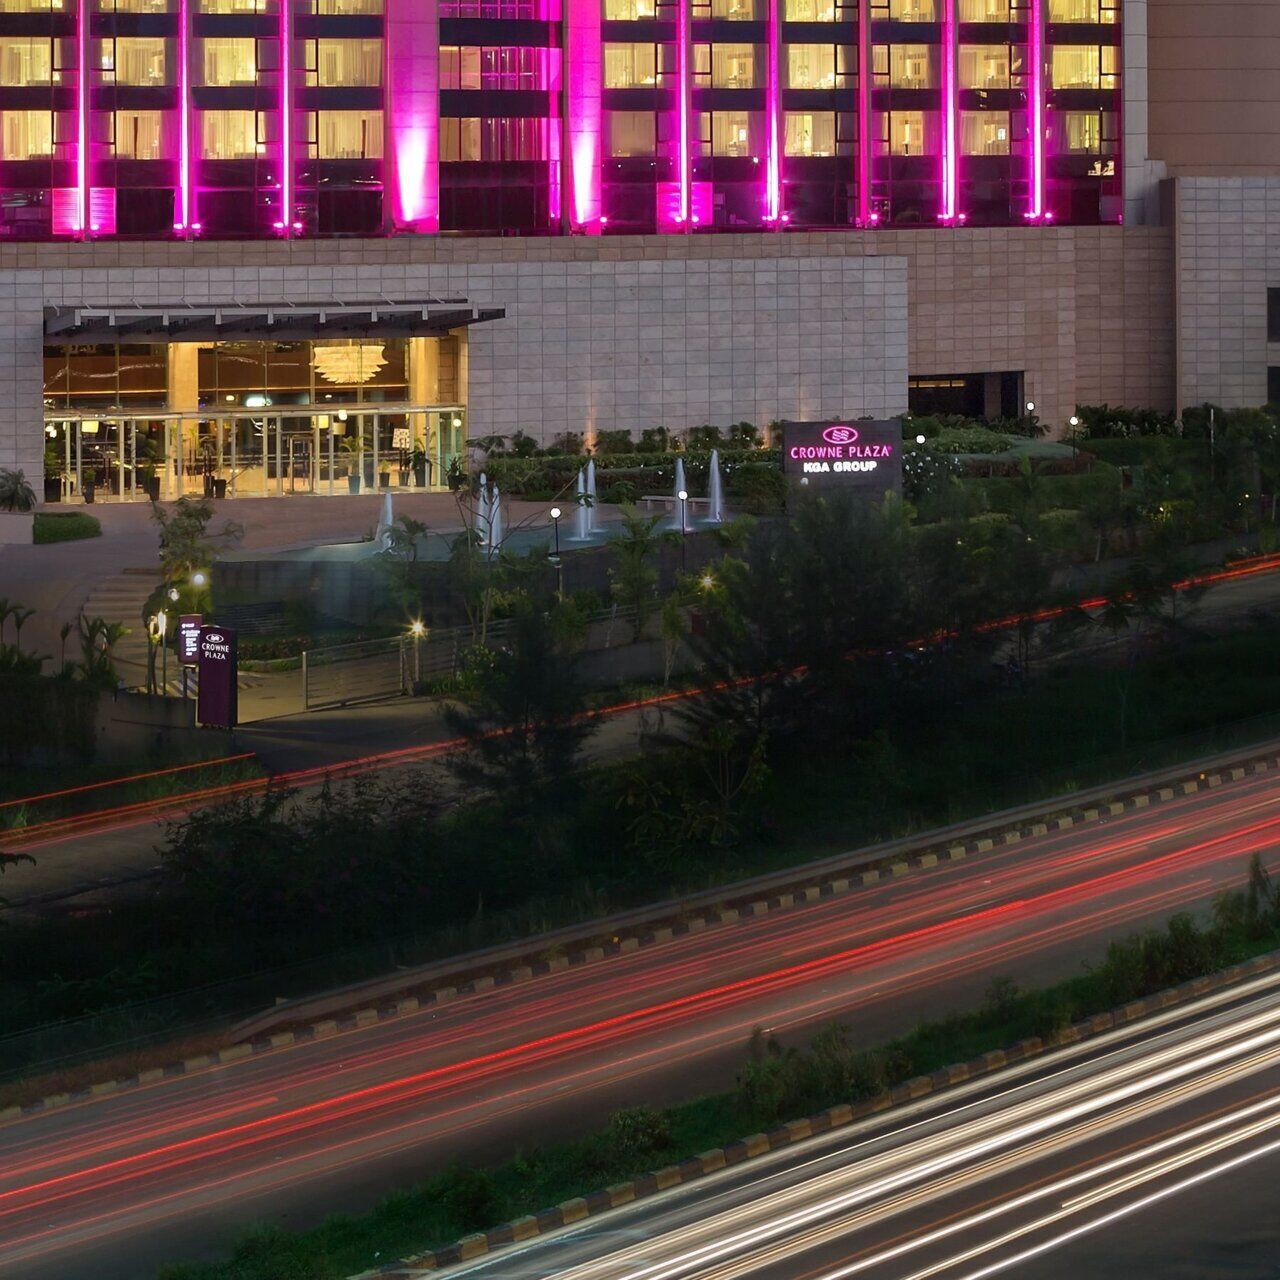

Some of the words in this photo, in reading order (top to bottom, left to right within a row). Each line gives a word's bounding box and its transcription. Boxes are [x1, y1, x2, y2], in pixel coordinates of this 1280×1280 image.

[791, 447, 842, 458] CROWNE
[849, 446, 889, 457] PLAZA
[803, 462, 830, 472] KGA
[833, 461, 877, 472] GROUP
[202, 643, 229, 652] CROWNE
[205, 651, 225, 659] PLAZA
